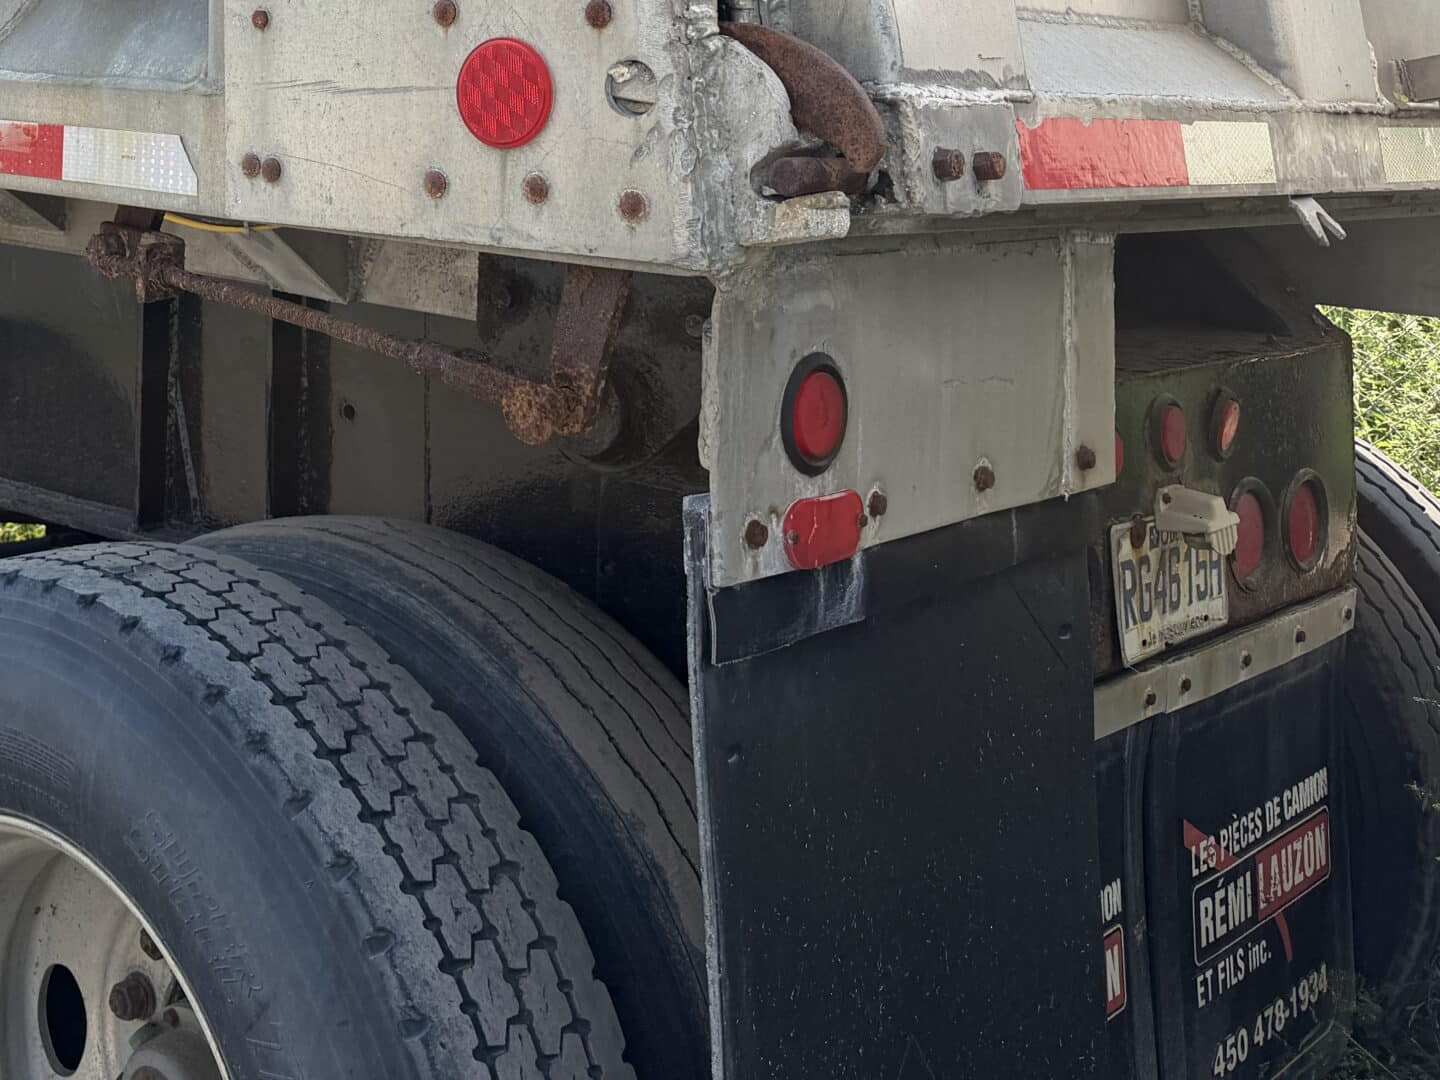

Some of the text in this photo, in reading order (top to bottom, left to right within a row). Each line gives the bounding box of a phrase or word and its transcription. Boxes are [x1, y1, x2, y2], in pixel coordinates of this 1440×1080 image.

[1191, 766, 1329, 877] LES PIÈCES DE CAMION
[1100, 877, 1122, 923] ION
[1199, 822, 1328, 949] RÉMI LAUZON
[1196, 968, 1213, 1009] ET
[1216, 949, 1246, 997] FILS
[1213, 1025, 1250, 1078] 450
